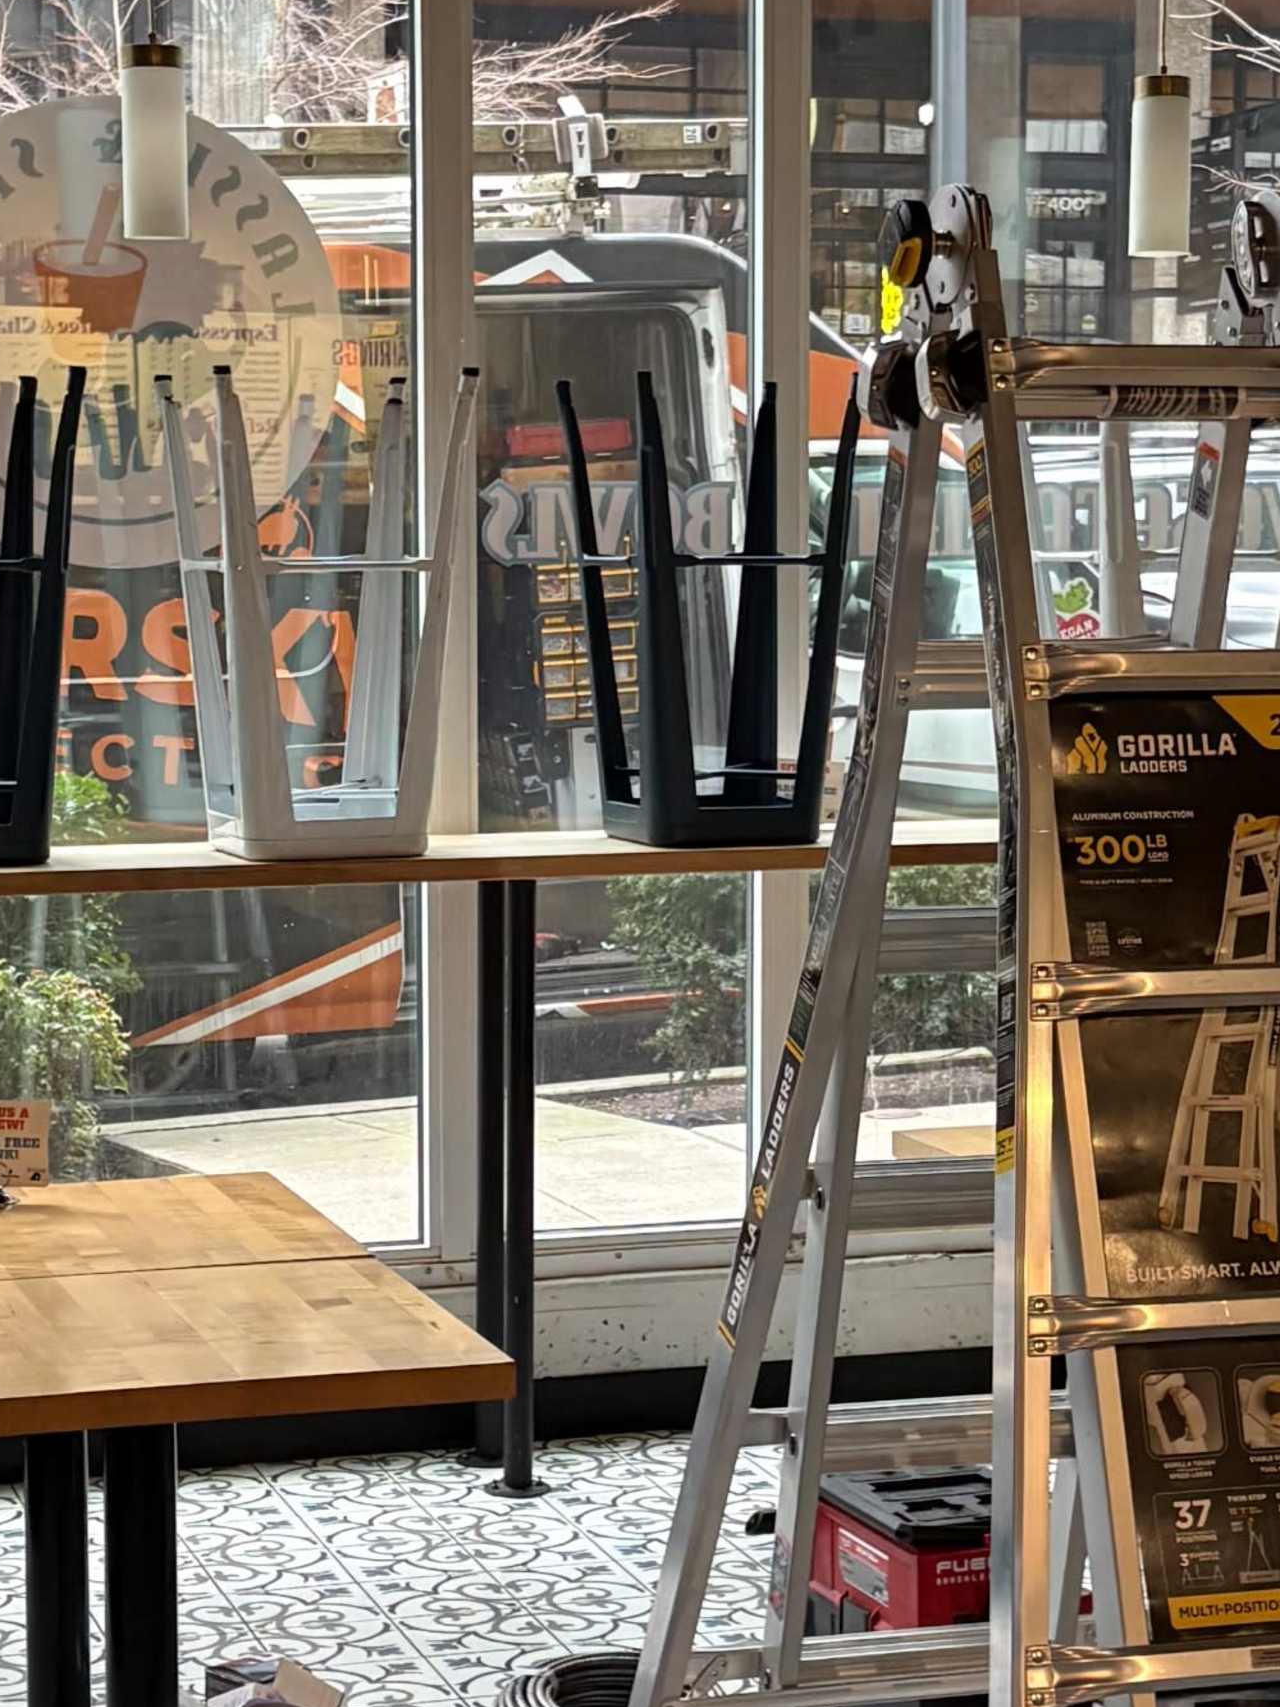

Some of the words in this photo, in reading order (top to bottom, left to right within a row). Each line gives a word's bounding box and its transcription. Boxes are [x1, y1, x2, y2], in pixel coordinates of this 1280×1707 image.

[1117, 733, 1237, 758] GORILLA
[1120, 760, 1187, 774] LADDERS
[1072, 811, 1121, 821] ALUMINUM
[1123, 810, 1194, 821] CONSTRUCTION
[1074, 835, 1146, 865] 300
[1146, 834, 1168, 848] LB
[19, 1107, 29, 1119] A
[760, 1062, 795, 1181] LADDERS
[4, 1137, 40, 1148] FREE
[726, 1222, 758, 1327] GORILLA
[1126, 1267, 1174, 1284] BUILT
[1180, 1263, 1246, 1280] SMART.
[1173, 1499, 1212, 1529] 37
[936, 1557, 990, 1575] FUE
